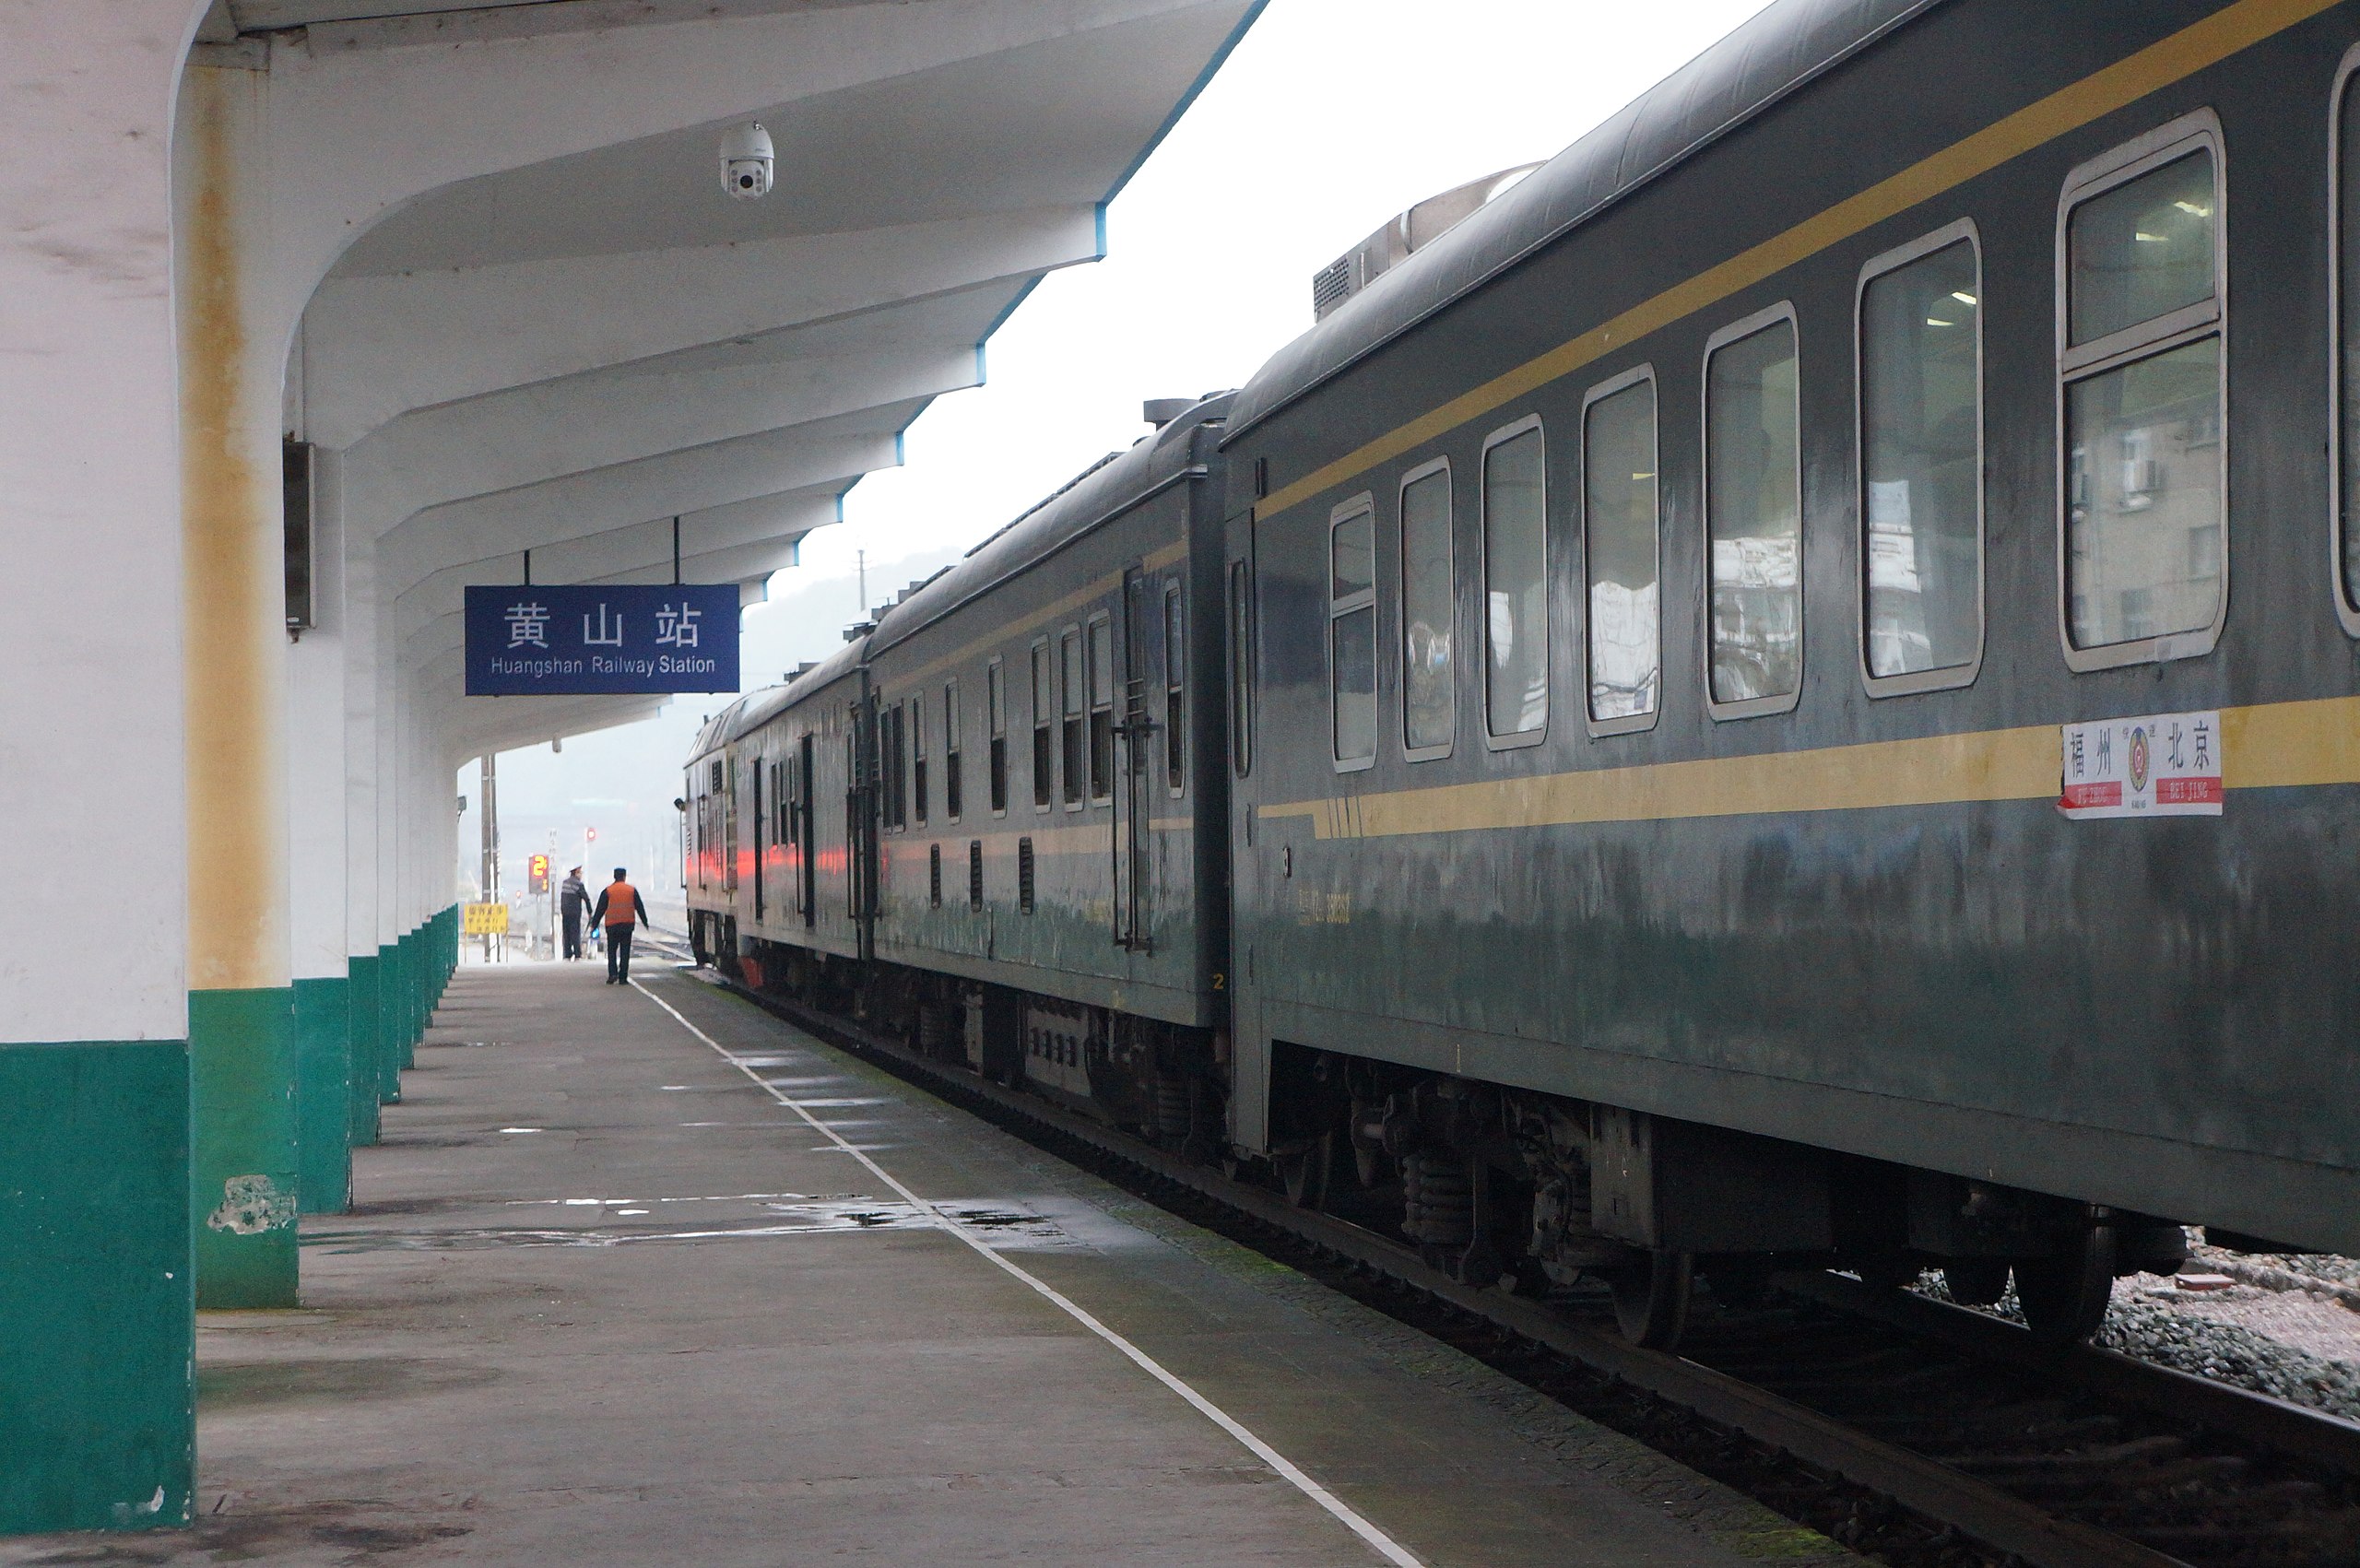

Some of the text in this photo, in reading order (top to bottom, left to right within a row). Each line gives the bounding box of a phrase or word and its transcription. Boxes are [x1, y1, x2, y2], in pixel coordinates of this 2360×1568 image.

[504, 601, 702, 649] 黄山站
[491, 654, 715, 678] Huangshan Railway Station
[2071, 720, 2209, 778] 福州 北京
[2188, 782, 2208, 800] JING
[1213, 973, 1224, 989] 2
